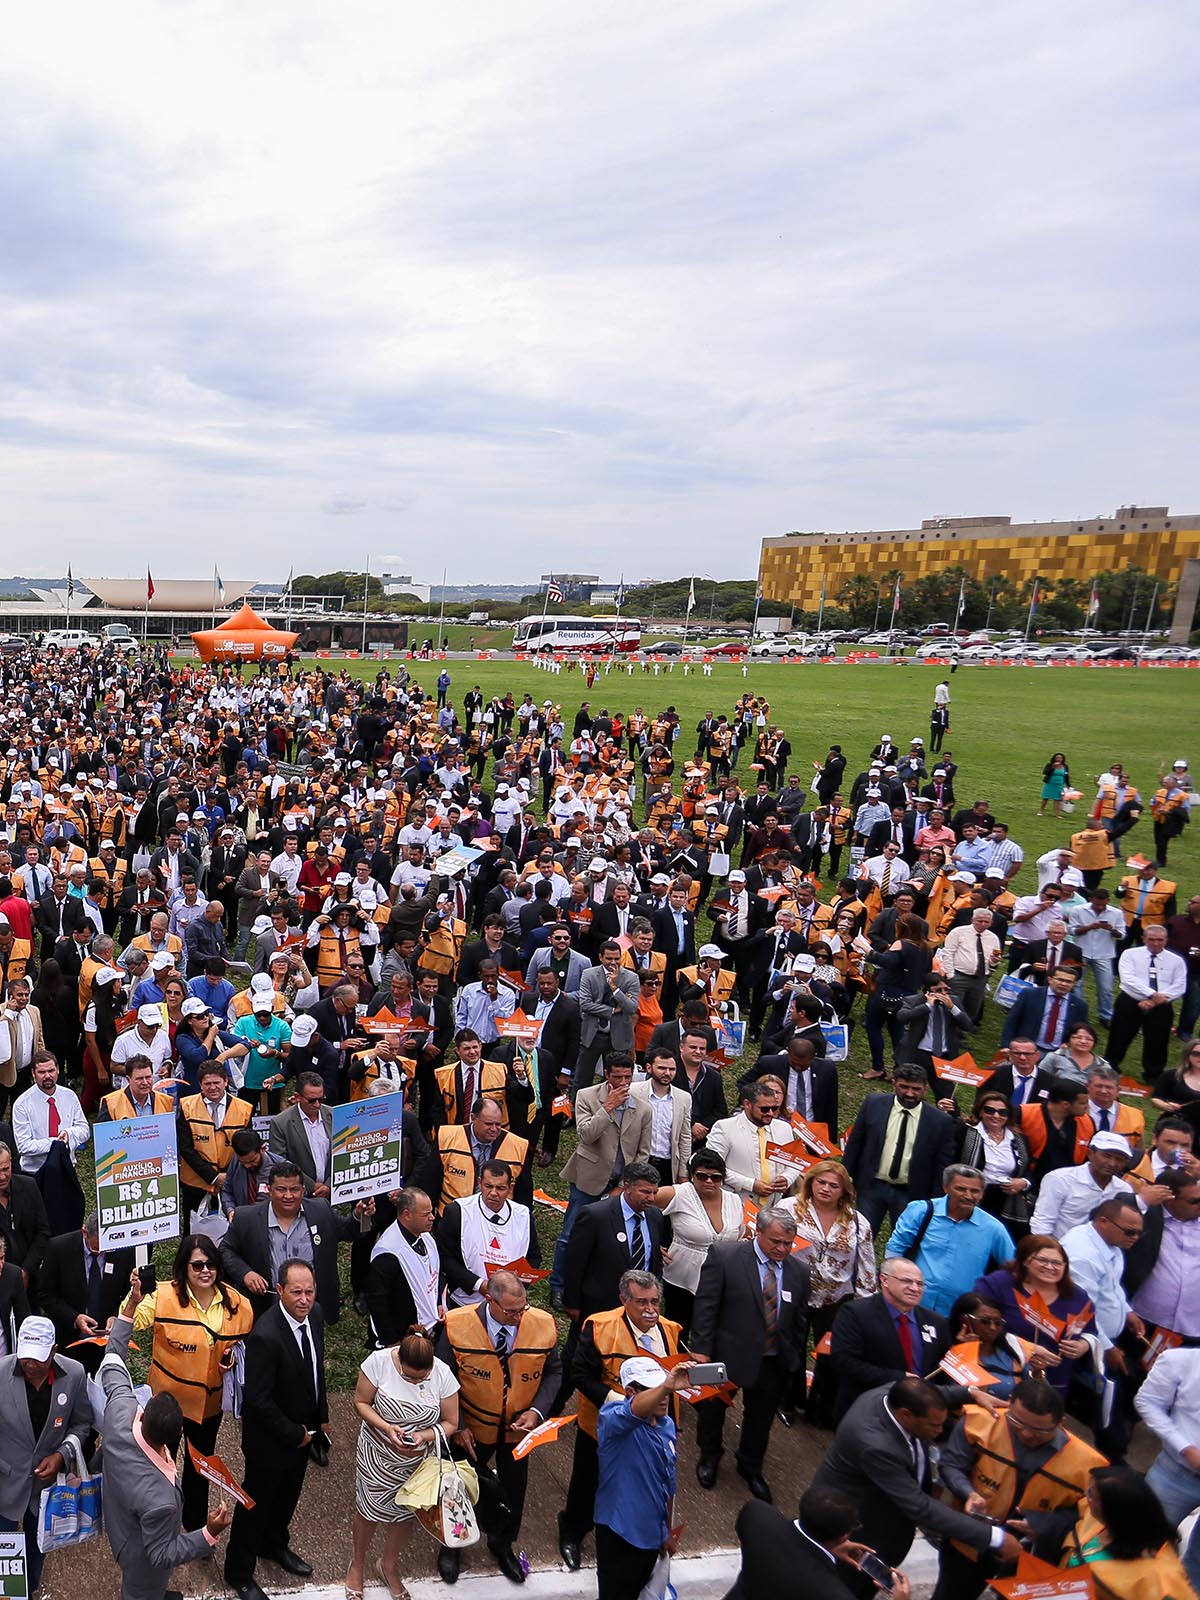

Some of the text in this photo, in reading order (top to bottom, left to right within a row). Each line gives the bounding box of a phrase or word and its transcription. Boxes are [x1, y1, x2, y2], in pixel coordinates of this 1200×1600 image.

[558, 630, 595, 639] Reunidas
[347, 1135, 388, 1150] FINANCEIRO
[354, 1132, 382, 1144] AUXÍLIO
[349, 1145, 384, 1165] R$ 4
[114, 1166, 162, 1181] FINANCEIRO
[122, 1161, 153, 1174] AUXÍLIO
[334, 1158, 398, 1185] BILHÕES
[451, 1166, 467, 1177] CNM
[118, 1178, 160, 1202] R$ 4
[101, 1196, 177, 1226] BILHÕES
[179, 1343, 197, 1352] CNM
[471, 1368, 491, 1379] CNM
[60, 1491, 75, 1501] CNM
